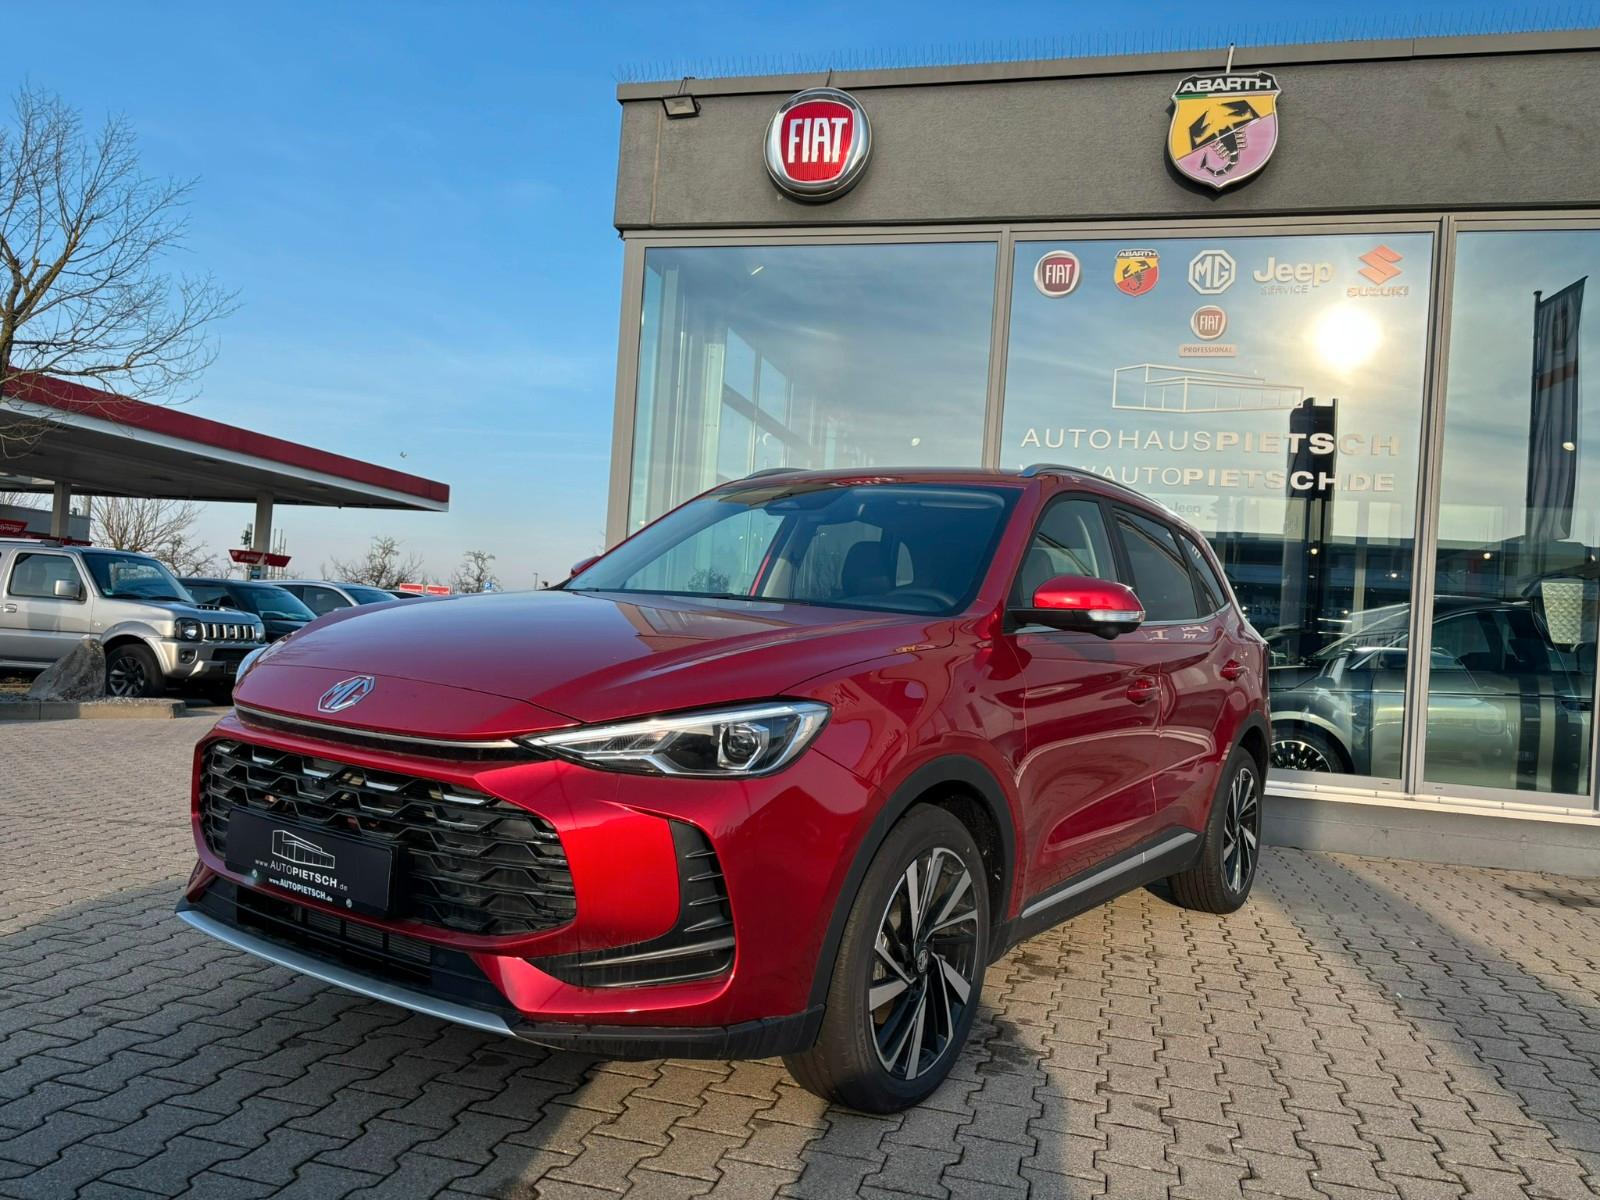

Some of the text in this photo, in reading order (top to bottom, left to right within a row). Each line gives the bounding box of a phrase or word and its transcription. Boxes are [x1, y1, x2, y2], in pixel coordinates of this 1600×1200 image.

[1180, 77, 1272, 93] ABARTH
[787, 117, 849, 164] FIAT
[1045, 263, 1073, 284] FIAT
[1192, 252, 1231, 289] MG
[1253, 256, 1335, 287] Jeep
[1347, 286, 1409, 297] SUZUKI
[1199, 314, 1220, 330] FIAT
[321, 677, 372, 711] MG
